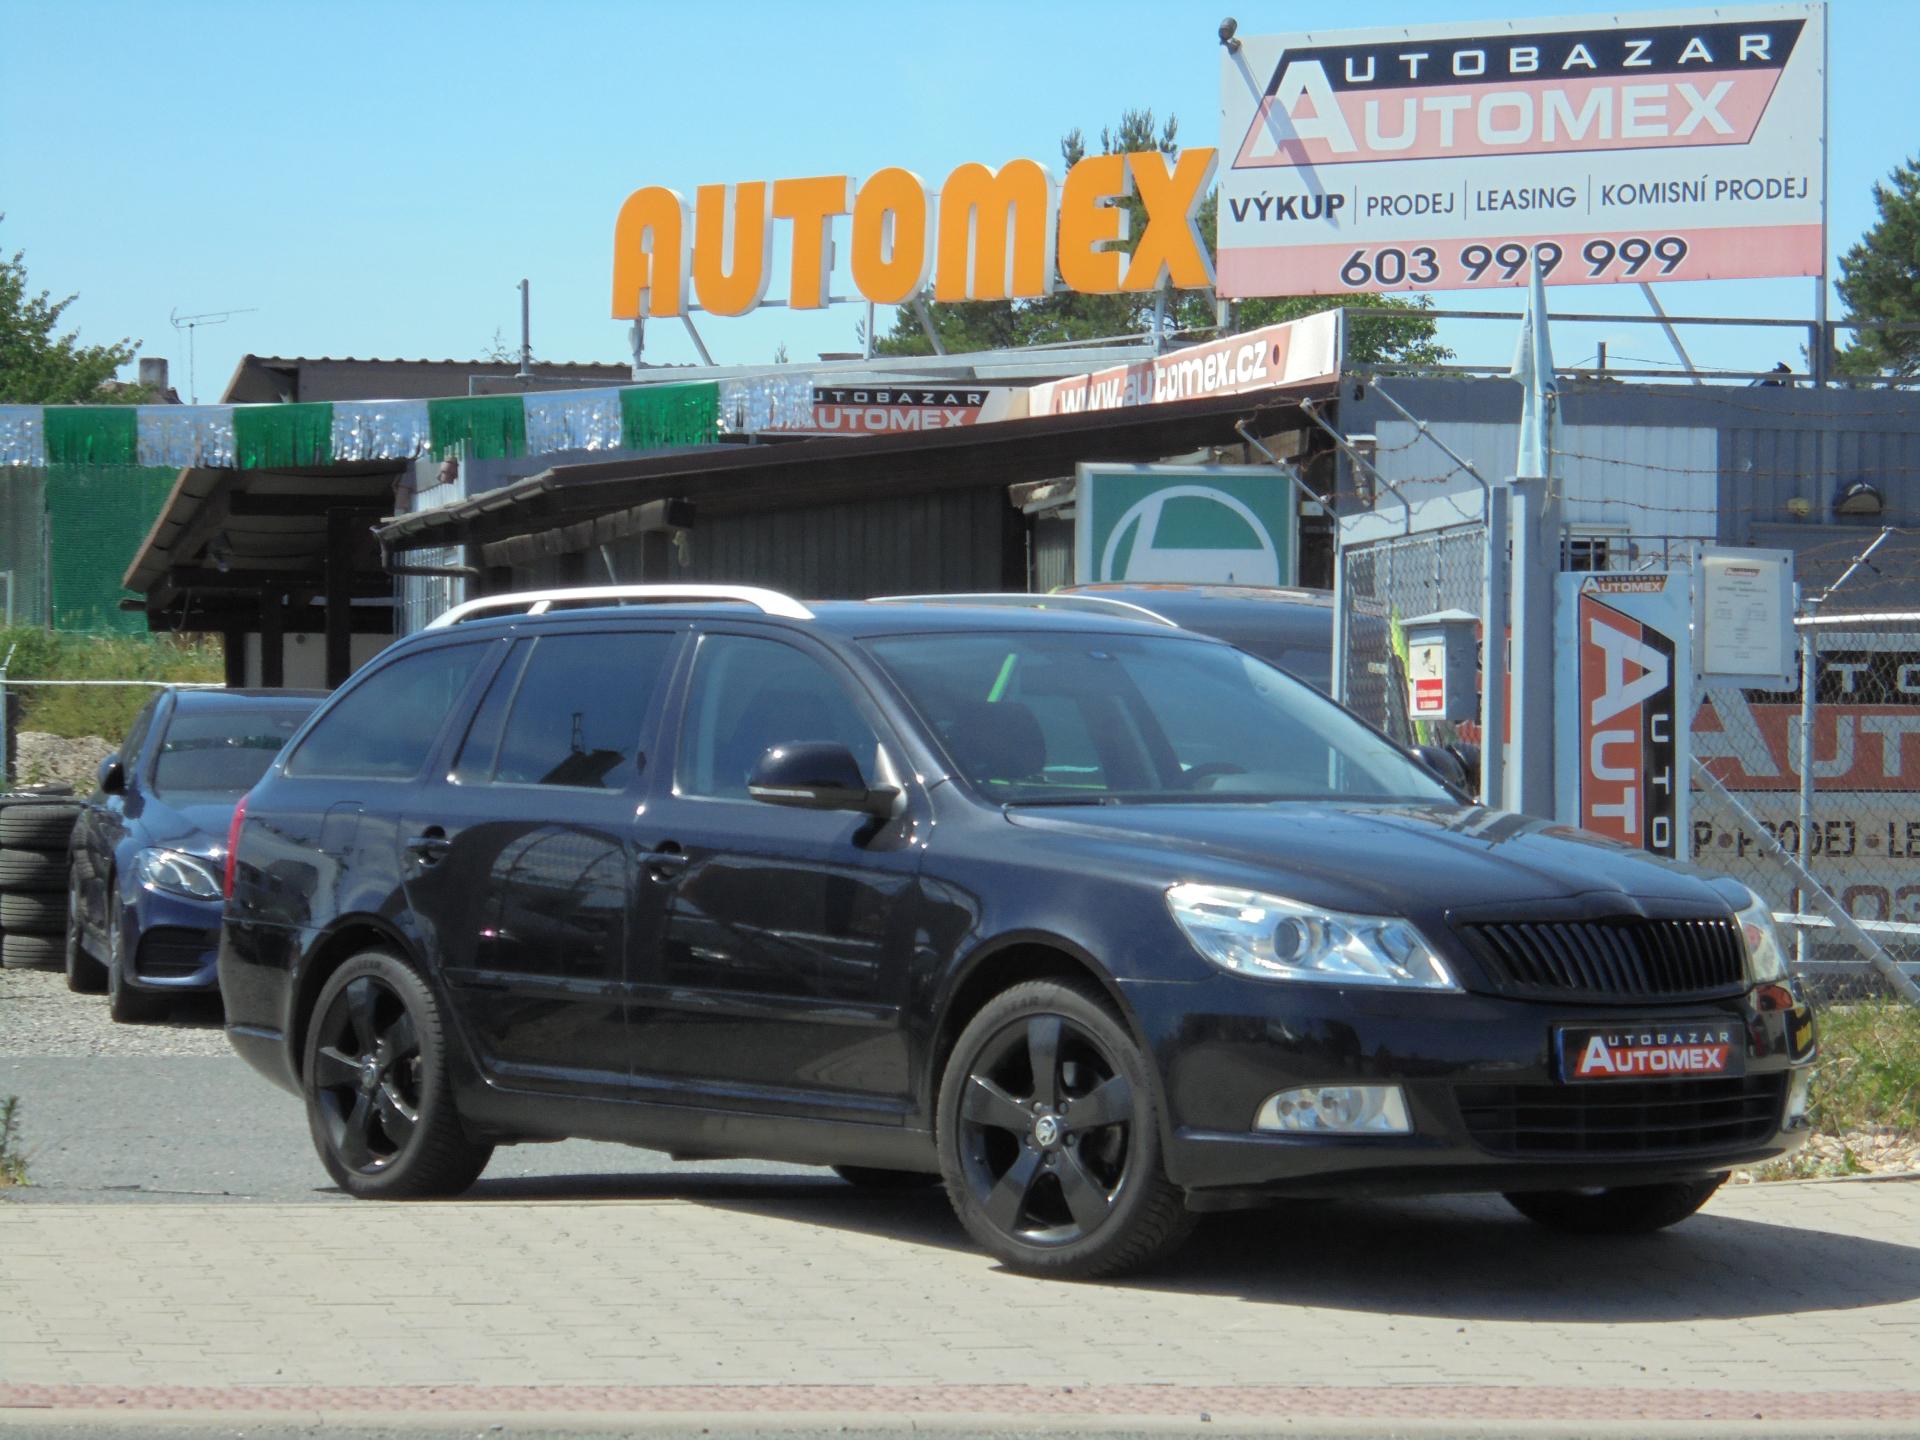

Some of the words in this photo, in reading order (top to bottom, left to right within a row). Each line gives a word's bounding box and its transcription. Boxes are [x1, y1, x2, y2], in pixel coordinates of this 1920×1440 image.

[1249, 59, 1736, 157] AUTOMEX
[1229, 190, 1345, 223] VÝKUP
[1366, 193, 1454, 217] PRODEJ
[1476, 187, 1577, 212] LEASING
[1601, 174, 1709, 206] KOMISNÍ
[1714, 176, 1808, 201] PRODEJ
[611, 148, 1218, 319] AUTOMEX
[1340, 245, 1439, 287] 603
[1459, 241, 1563, 283] 999
[1581, 235, 1689, 278] 999
[1061, 340, 1268, 412] www.automex.cz
[1582, 577, 1660, 592] AUTOMEX
[1580, 1036, 1721, 1073] AUTOMEX
